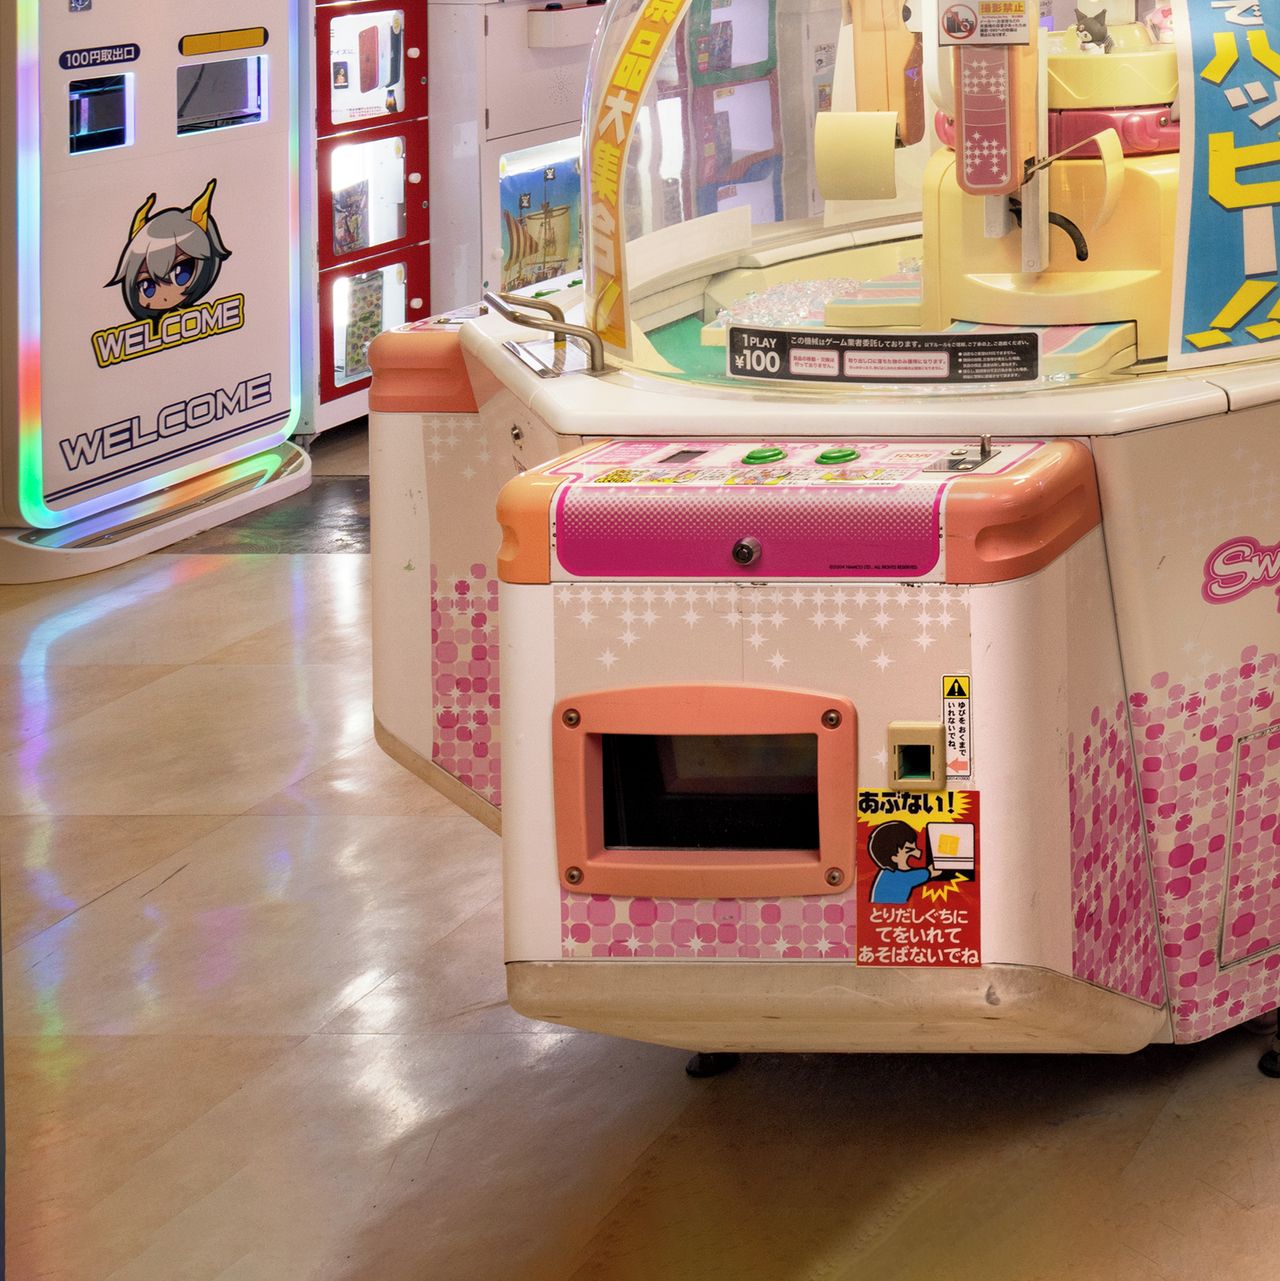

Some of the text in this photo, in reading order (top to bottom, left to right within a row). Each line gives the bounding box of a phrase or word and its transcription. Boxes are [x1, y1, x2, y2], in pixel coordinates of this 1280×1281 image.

[64, 46, 136, 68] 100円取出口
[96, 299, 243, 363] WELCOME
[735, 350, 781, 373] ¥100
[59, 373, 272, 471] WELCOME
[946, 701, 957, 751] いれないでね。
[858, 791, 956, 815] あぶない!
[869, 907, 969, 925] とりだしぐちに
[875, 926, 963, 944] てをいれて
[858, 946, 980, 965] あそばないでね
